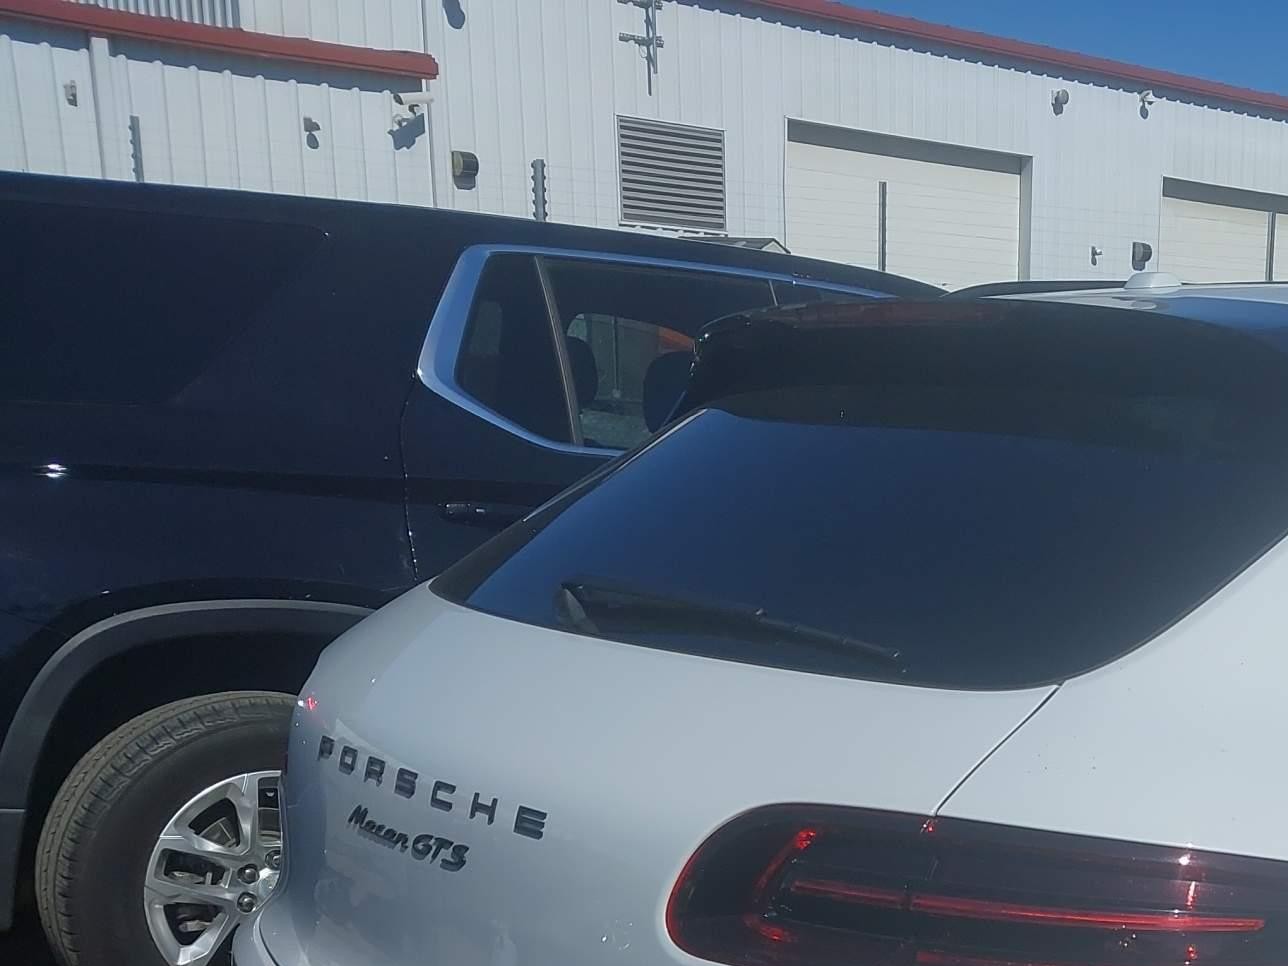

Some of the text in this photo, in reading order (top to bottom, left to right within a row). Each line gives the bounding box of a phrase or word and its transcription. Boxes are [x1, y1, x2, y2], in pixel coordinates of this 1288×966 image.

[317, 735, 548, 840] PORSCHE
[347, 804, 470, 872] Macan GTS
